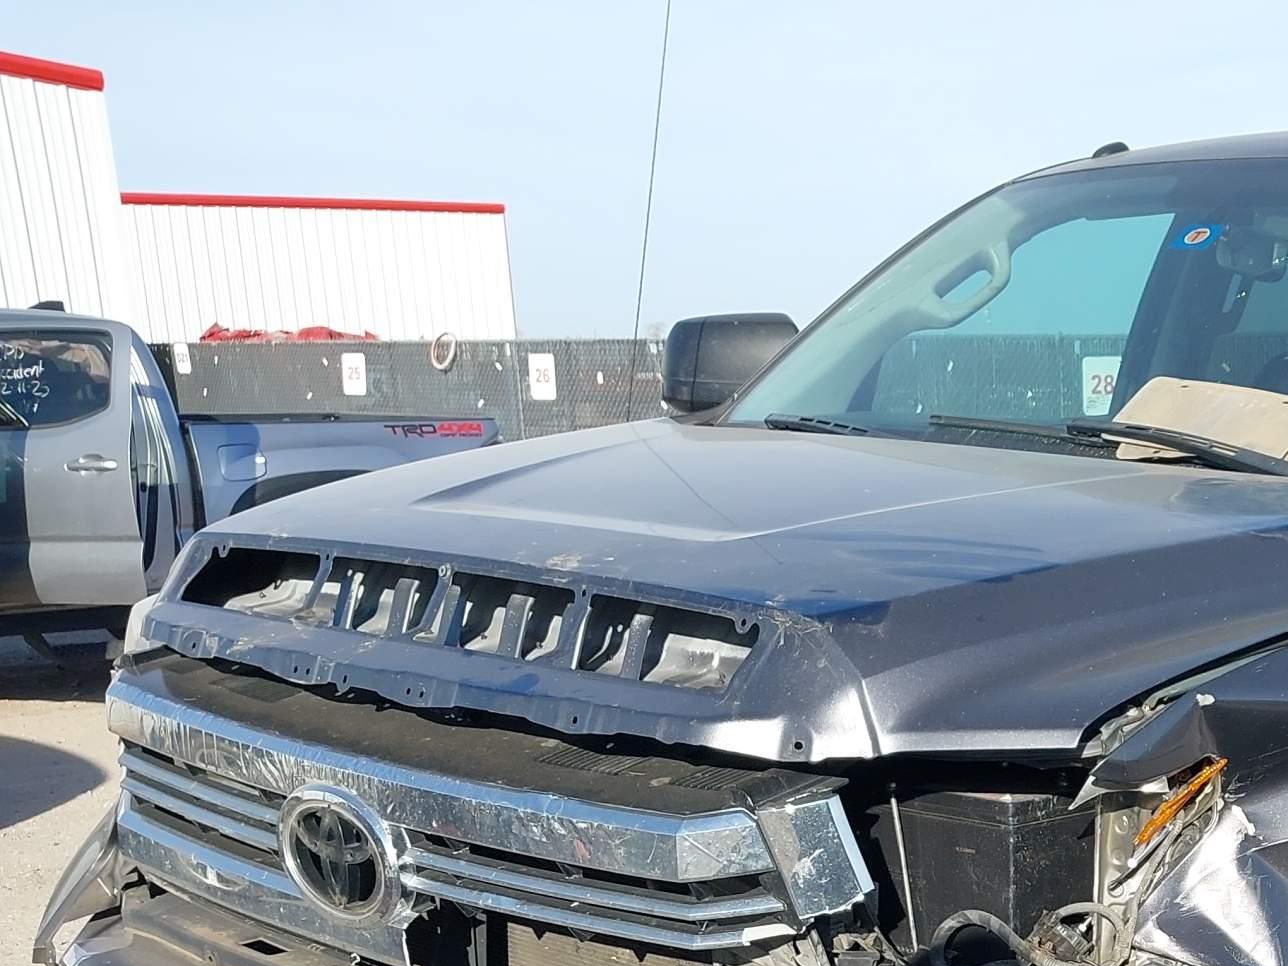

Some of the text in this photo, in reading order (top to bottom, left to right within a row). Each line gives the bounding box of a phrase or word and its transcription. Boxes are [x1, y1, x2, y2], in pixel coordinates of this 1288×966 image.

[0, 360, 45, 380] ccident
[347, 366, 361, 380] 25
[535, 368, 550, 383] 26
[1091, 374, 1115, 395] 28
[384, 424, 437, 438] TRD
